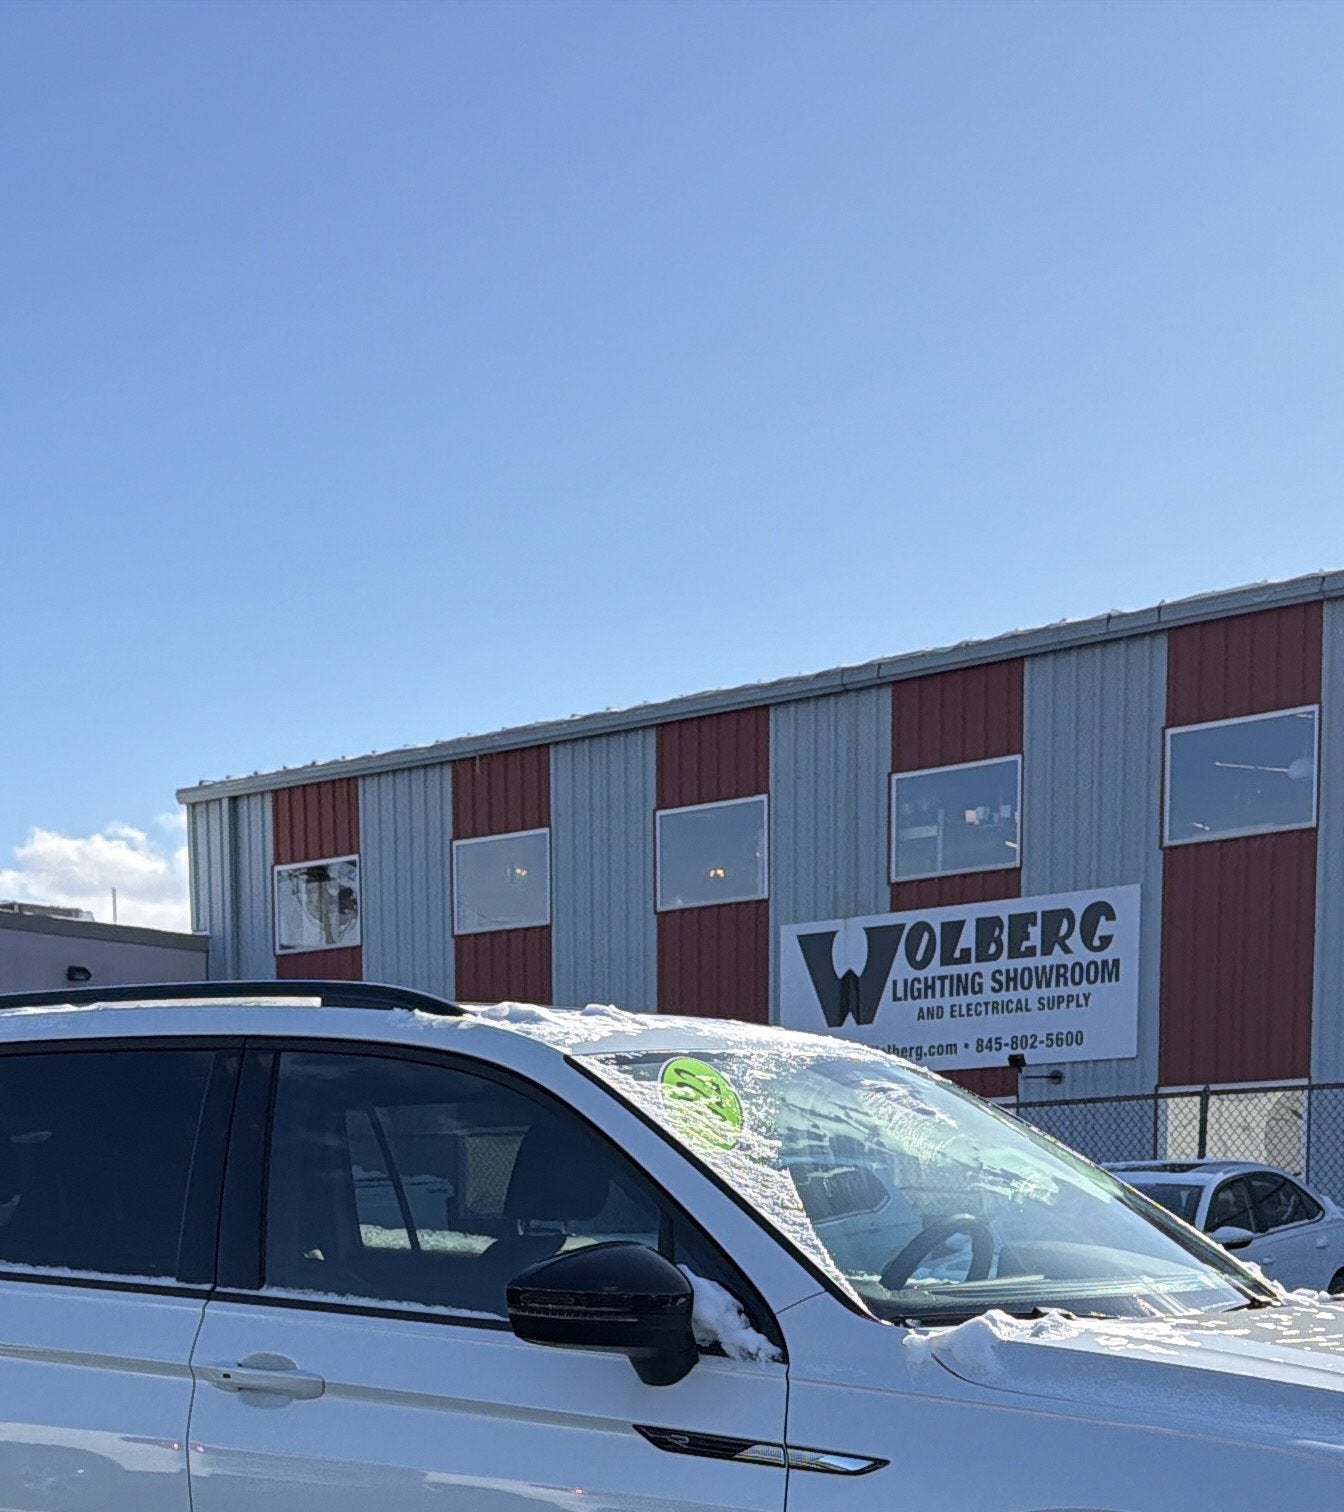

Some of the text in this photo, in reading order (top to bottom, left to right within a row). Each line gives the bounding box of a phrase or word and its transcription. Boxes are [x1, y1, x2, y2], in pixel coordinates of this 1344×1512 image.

[796, 901, 1117, 1028] WOLBERG
[892, 958, 1121, 1002] LIGHTING SHOWROOM
[917, 992, 1092, 1021] AND ELECTRICAL SUPPLY
[975, 1030, 1085, 1053] 845-802-5600
